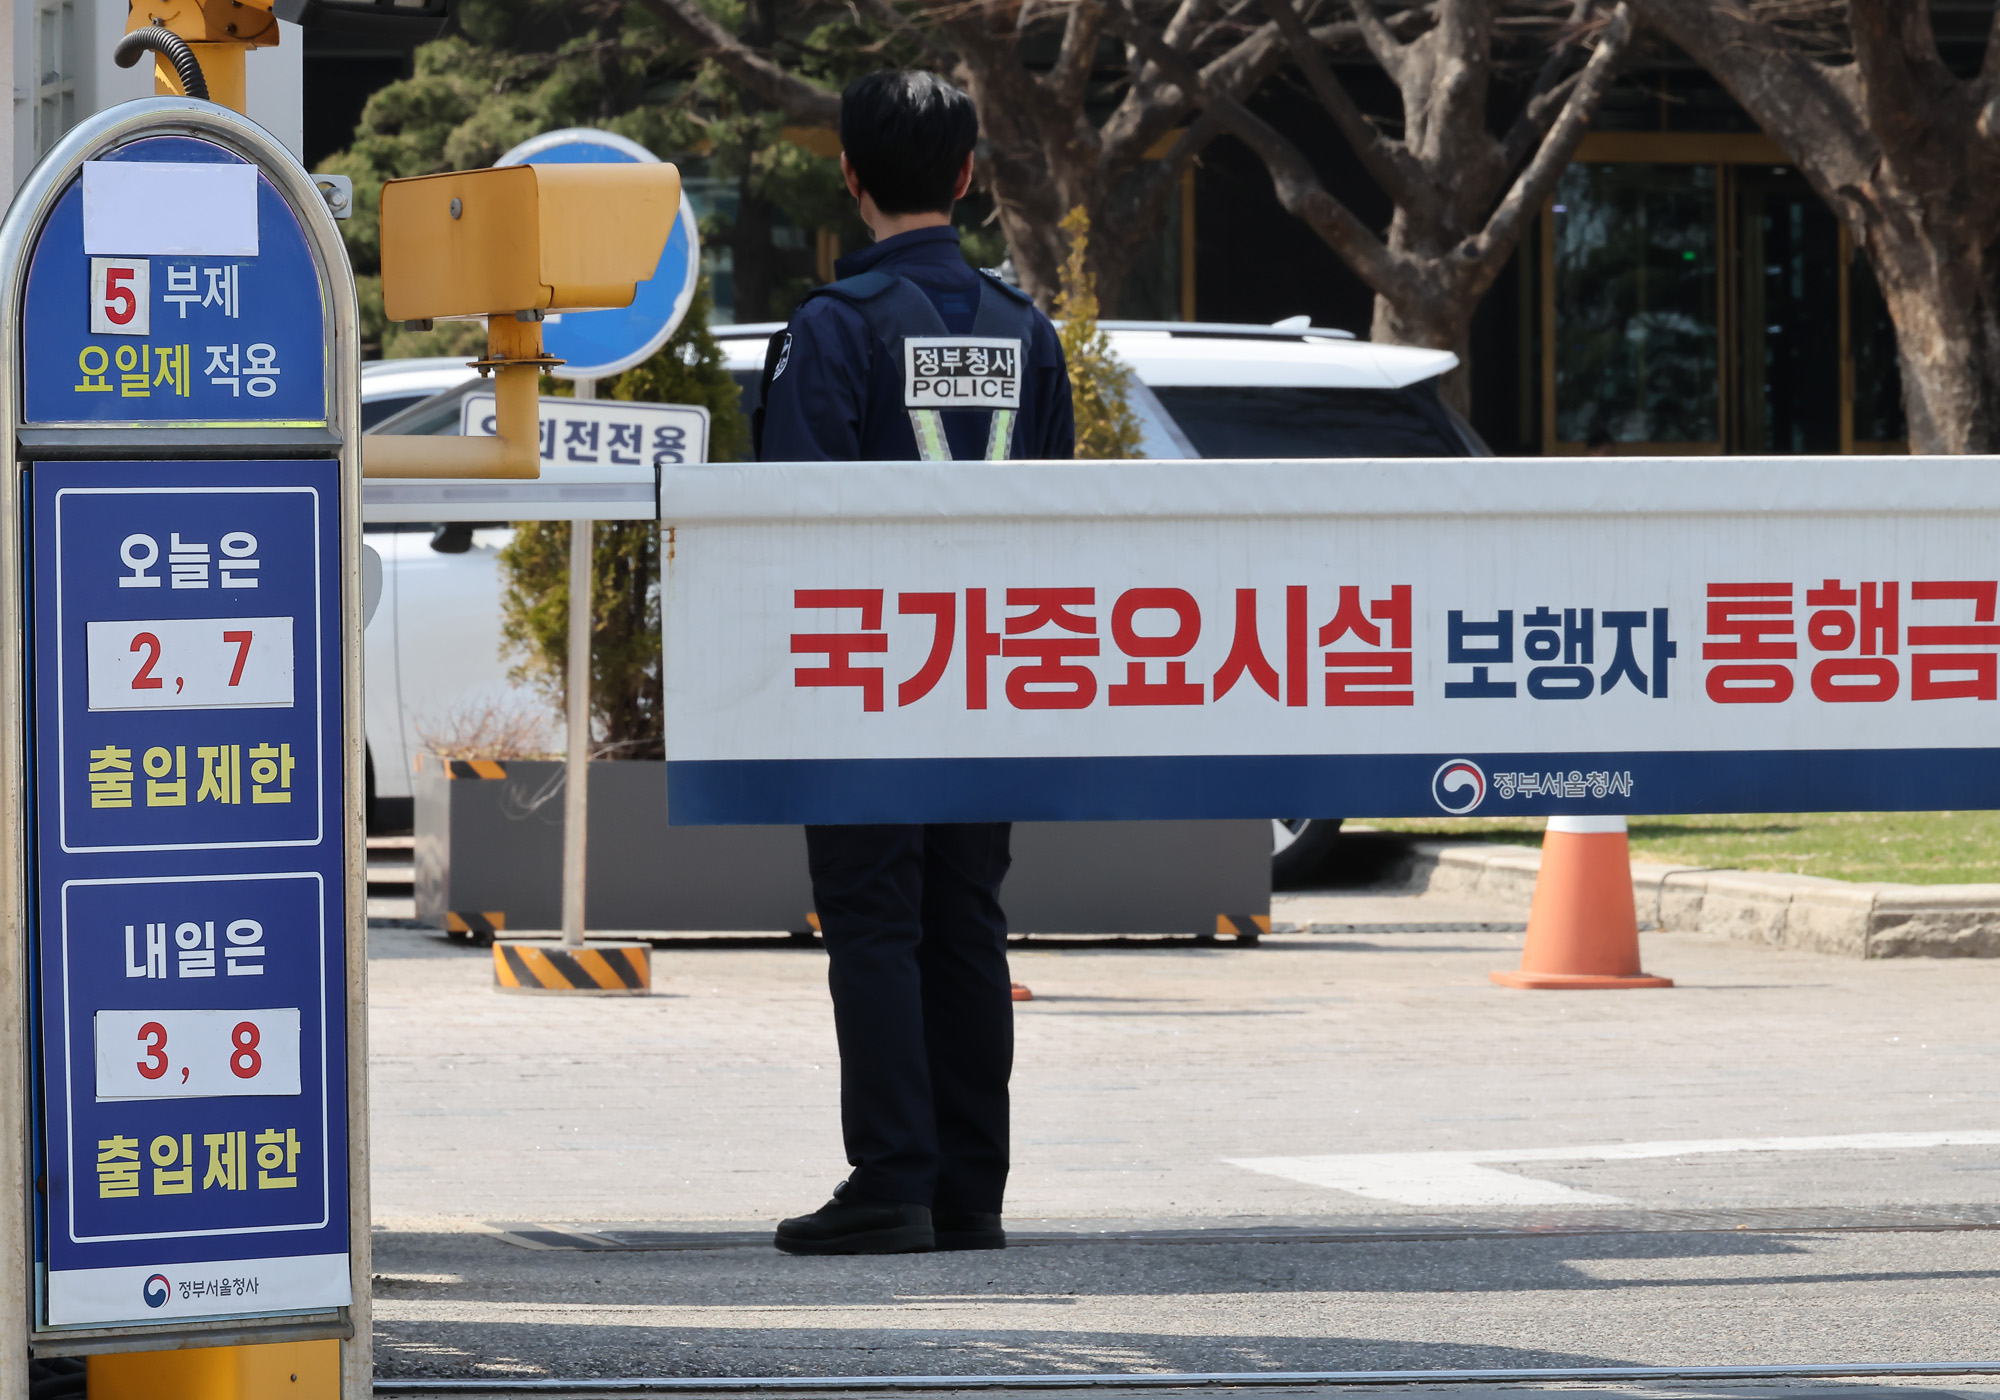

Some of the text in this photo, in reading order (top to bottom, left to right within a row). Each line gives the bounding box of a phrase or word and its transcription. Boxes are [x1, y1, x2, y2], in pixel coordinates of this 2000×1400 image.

[104, 264, 239, 325] 5 부제
[74, 342, 281, 398] 요일제 적용
[912, 378, 1015, 398] POLICE
[914, 347, 1014, 376] 정부청사
[118, 531, 260, 589] 오늘은
[129, 630, 253, 695] 2, 7
[790, 579, 2000, 712] 국가중요시설 보행자 통행금
[88, 742, 295, 809] 출입제한
[1493, 770, 1634, 800] 정부서울청사
[124, 918, 266, 979] 내일은
[136, 1021, 262, 1085] 3, 8
[96, 1128, 301, 1199] 출입제한
[178, 1276, 259, 1300] 정부서울청사
